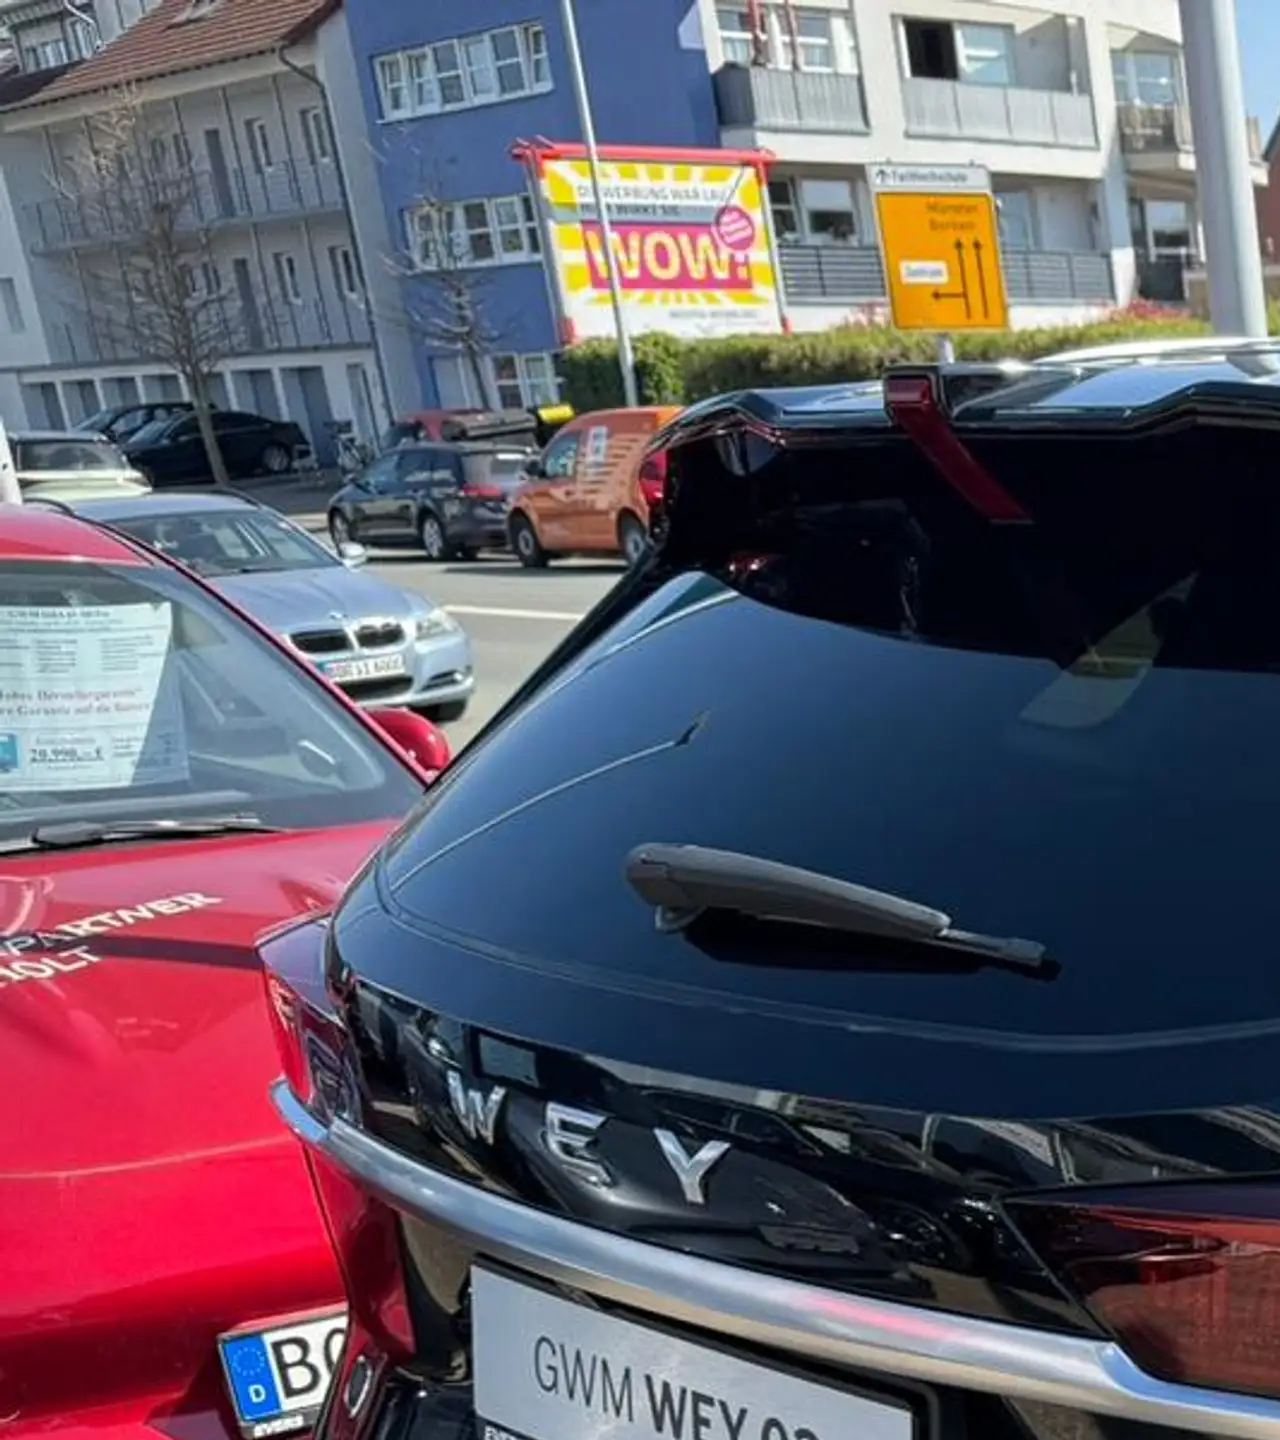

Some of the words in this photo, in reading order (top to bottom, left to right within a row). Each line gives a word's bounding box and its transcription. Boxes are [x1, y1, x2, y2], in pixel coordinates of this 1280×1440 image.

[0, 892, 223, 957] PARTNER
[447, 1069, 732, 1204] WEY
[534, 1335, 634, 1423] GWM
